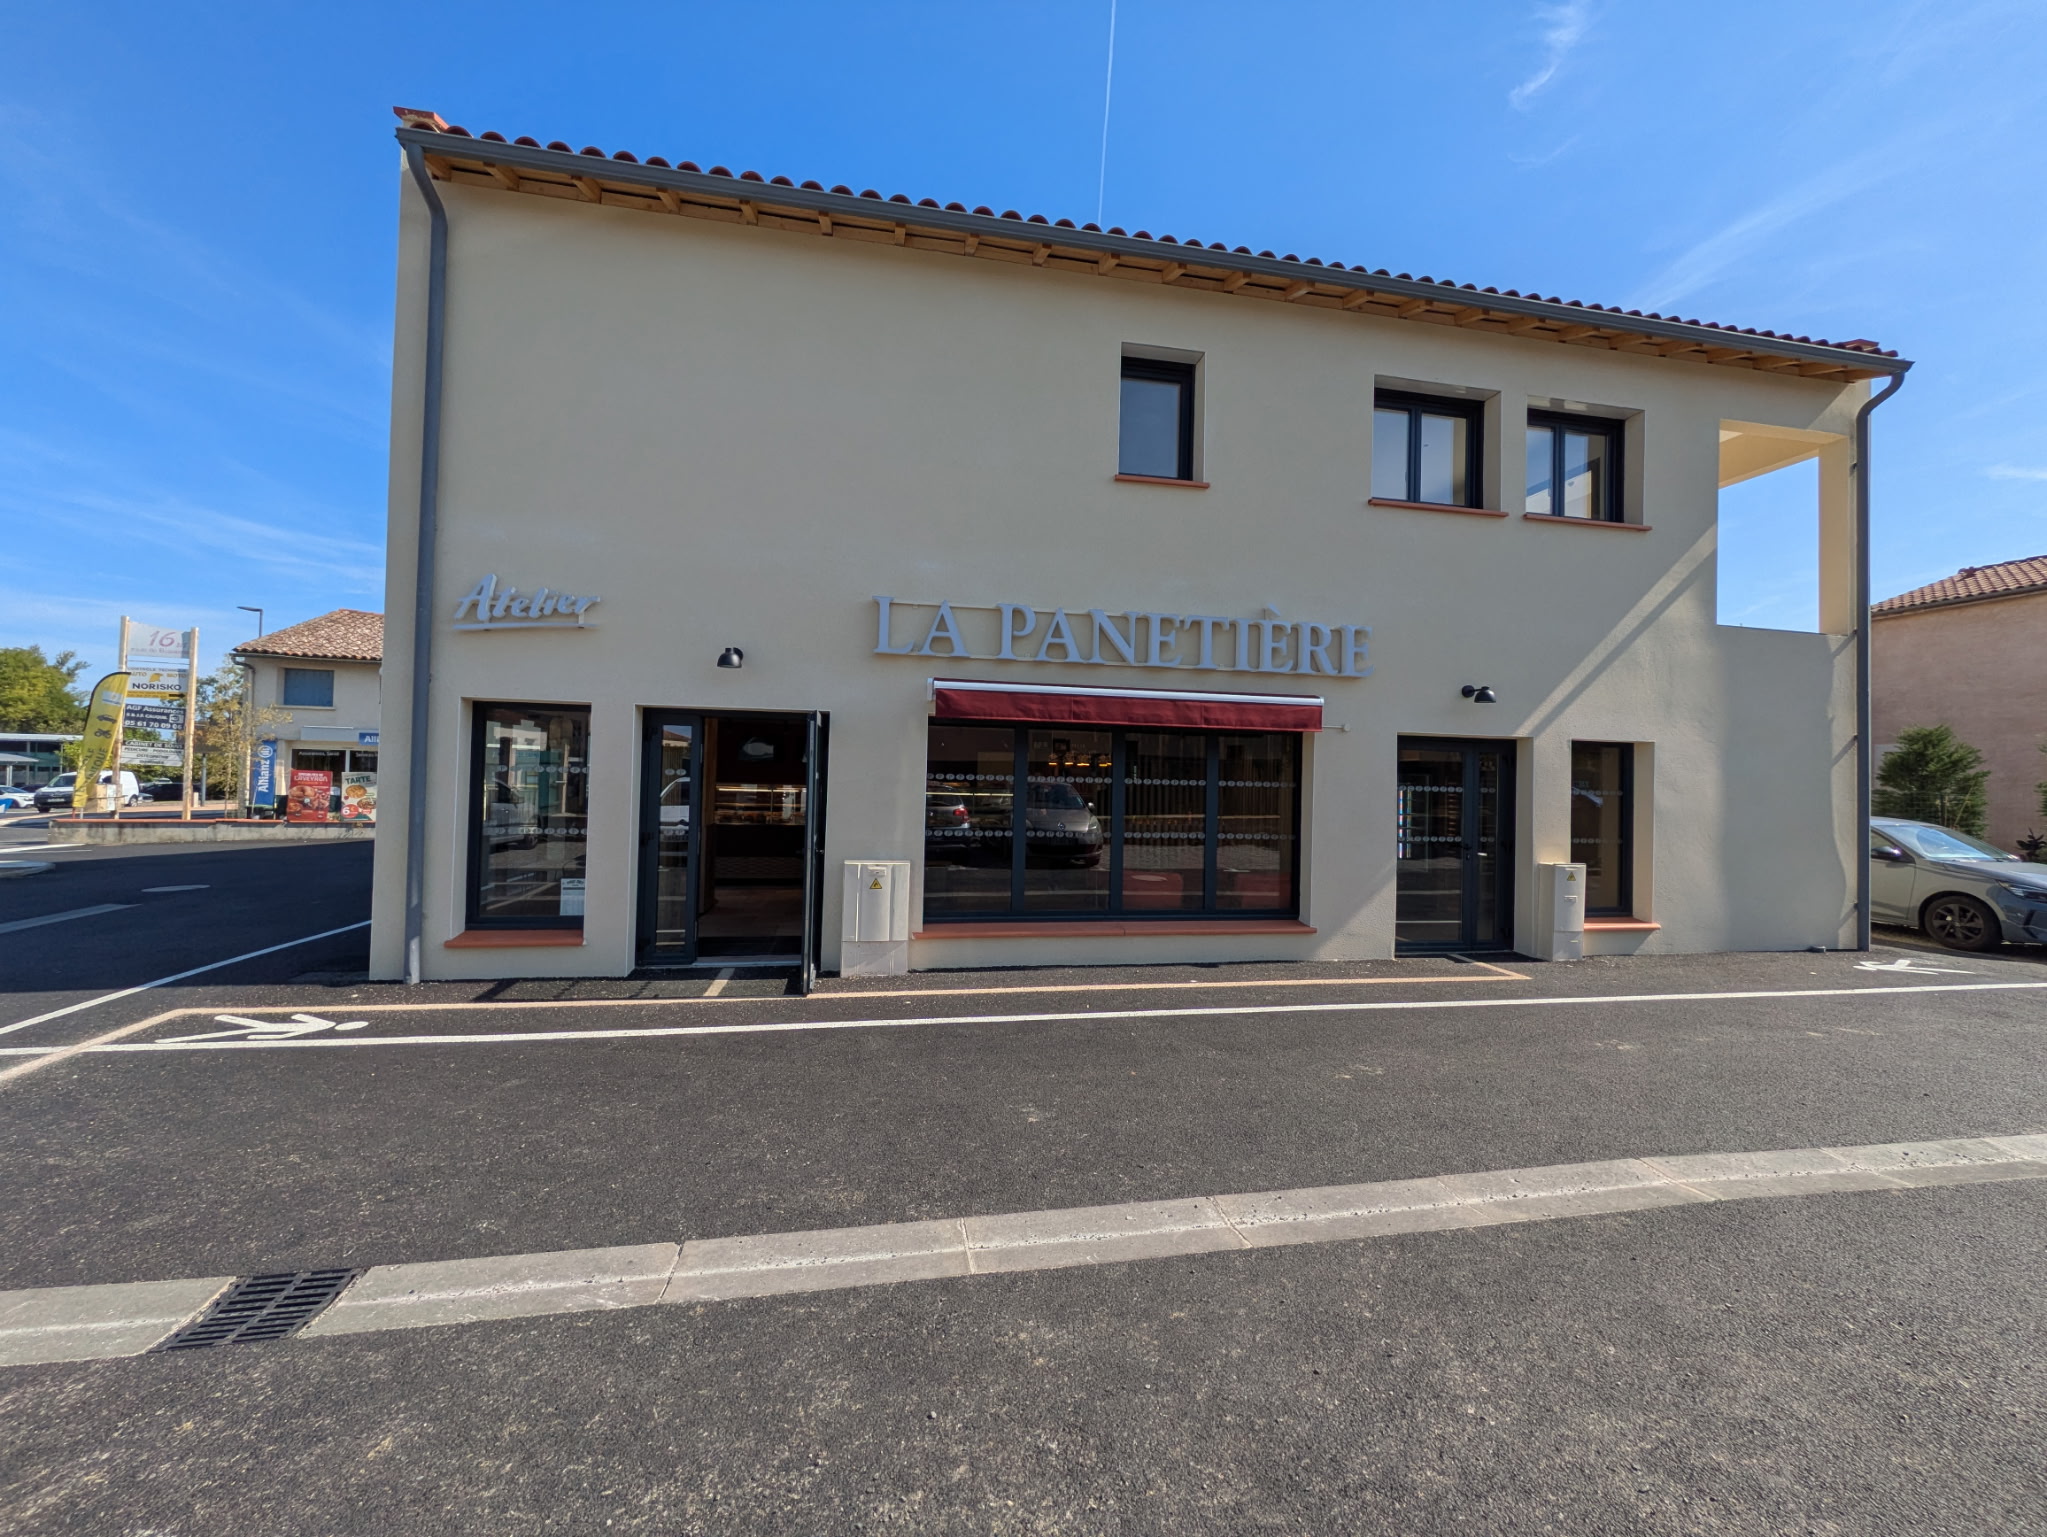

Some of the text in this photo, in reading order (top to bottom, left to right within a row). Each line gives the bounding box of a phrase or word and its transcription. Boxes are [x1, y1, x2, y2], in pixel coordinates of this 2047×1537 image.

[454, 573, 601, 621] Atelier
[149, 630, 176, 647] 16
[872, 595, 1375, 677] LA PANETIÈRE
[132, 682, 182, 691] NORISKO
[143, 706, 184, 714] Assurances
[257, 759, 270, 793] Allianz
[345, 775, 371, 785] TARTE
